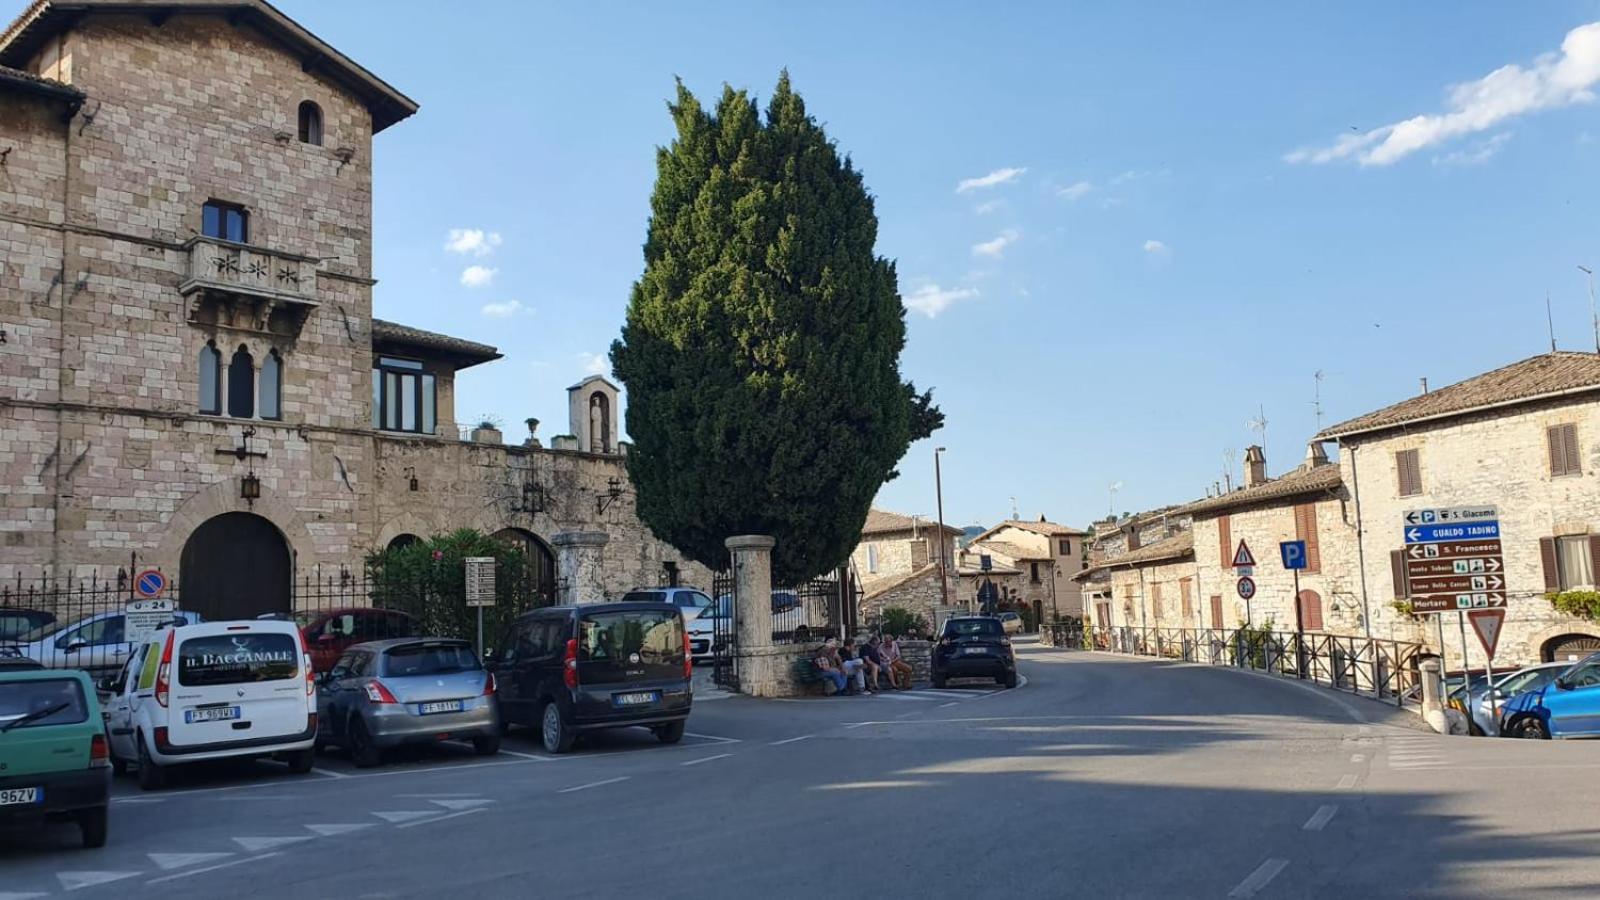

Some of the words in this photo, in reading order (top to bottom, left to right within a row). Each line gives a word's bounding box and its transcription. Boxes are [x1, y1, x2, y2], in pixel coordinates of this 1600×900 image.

[1462, 510, 1495, 519] Giacomo
[1432, 529, 1464, 538] GUALDO
[1467, 526, 1497, 535] TADINO
[1455, 544, 1499, 553] Francesco
[1286, 544, 1300, 567] P
[152, 601, 165, 610] 24
[1414, 600, 1448, 608] Mortaro
[202, 650, 293, 666] BACCANALE
[1, 788, 34, 804] 96ZV
